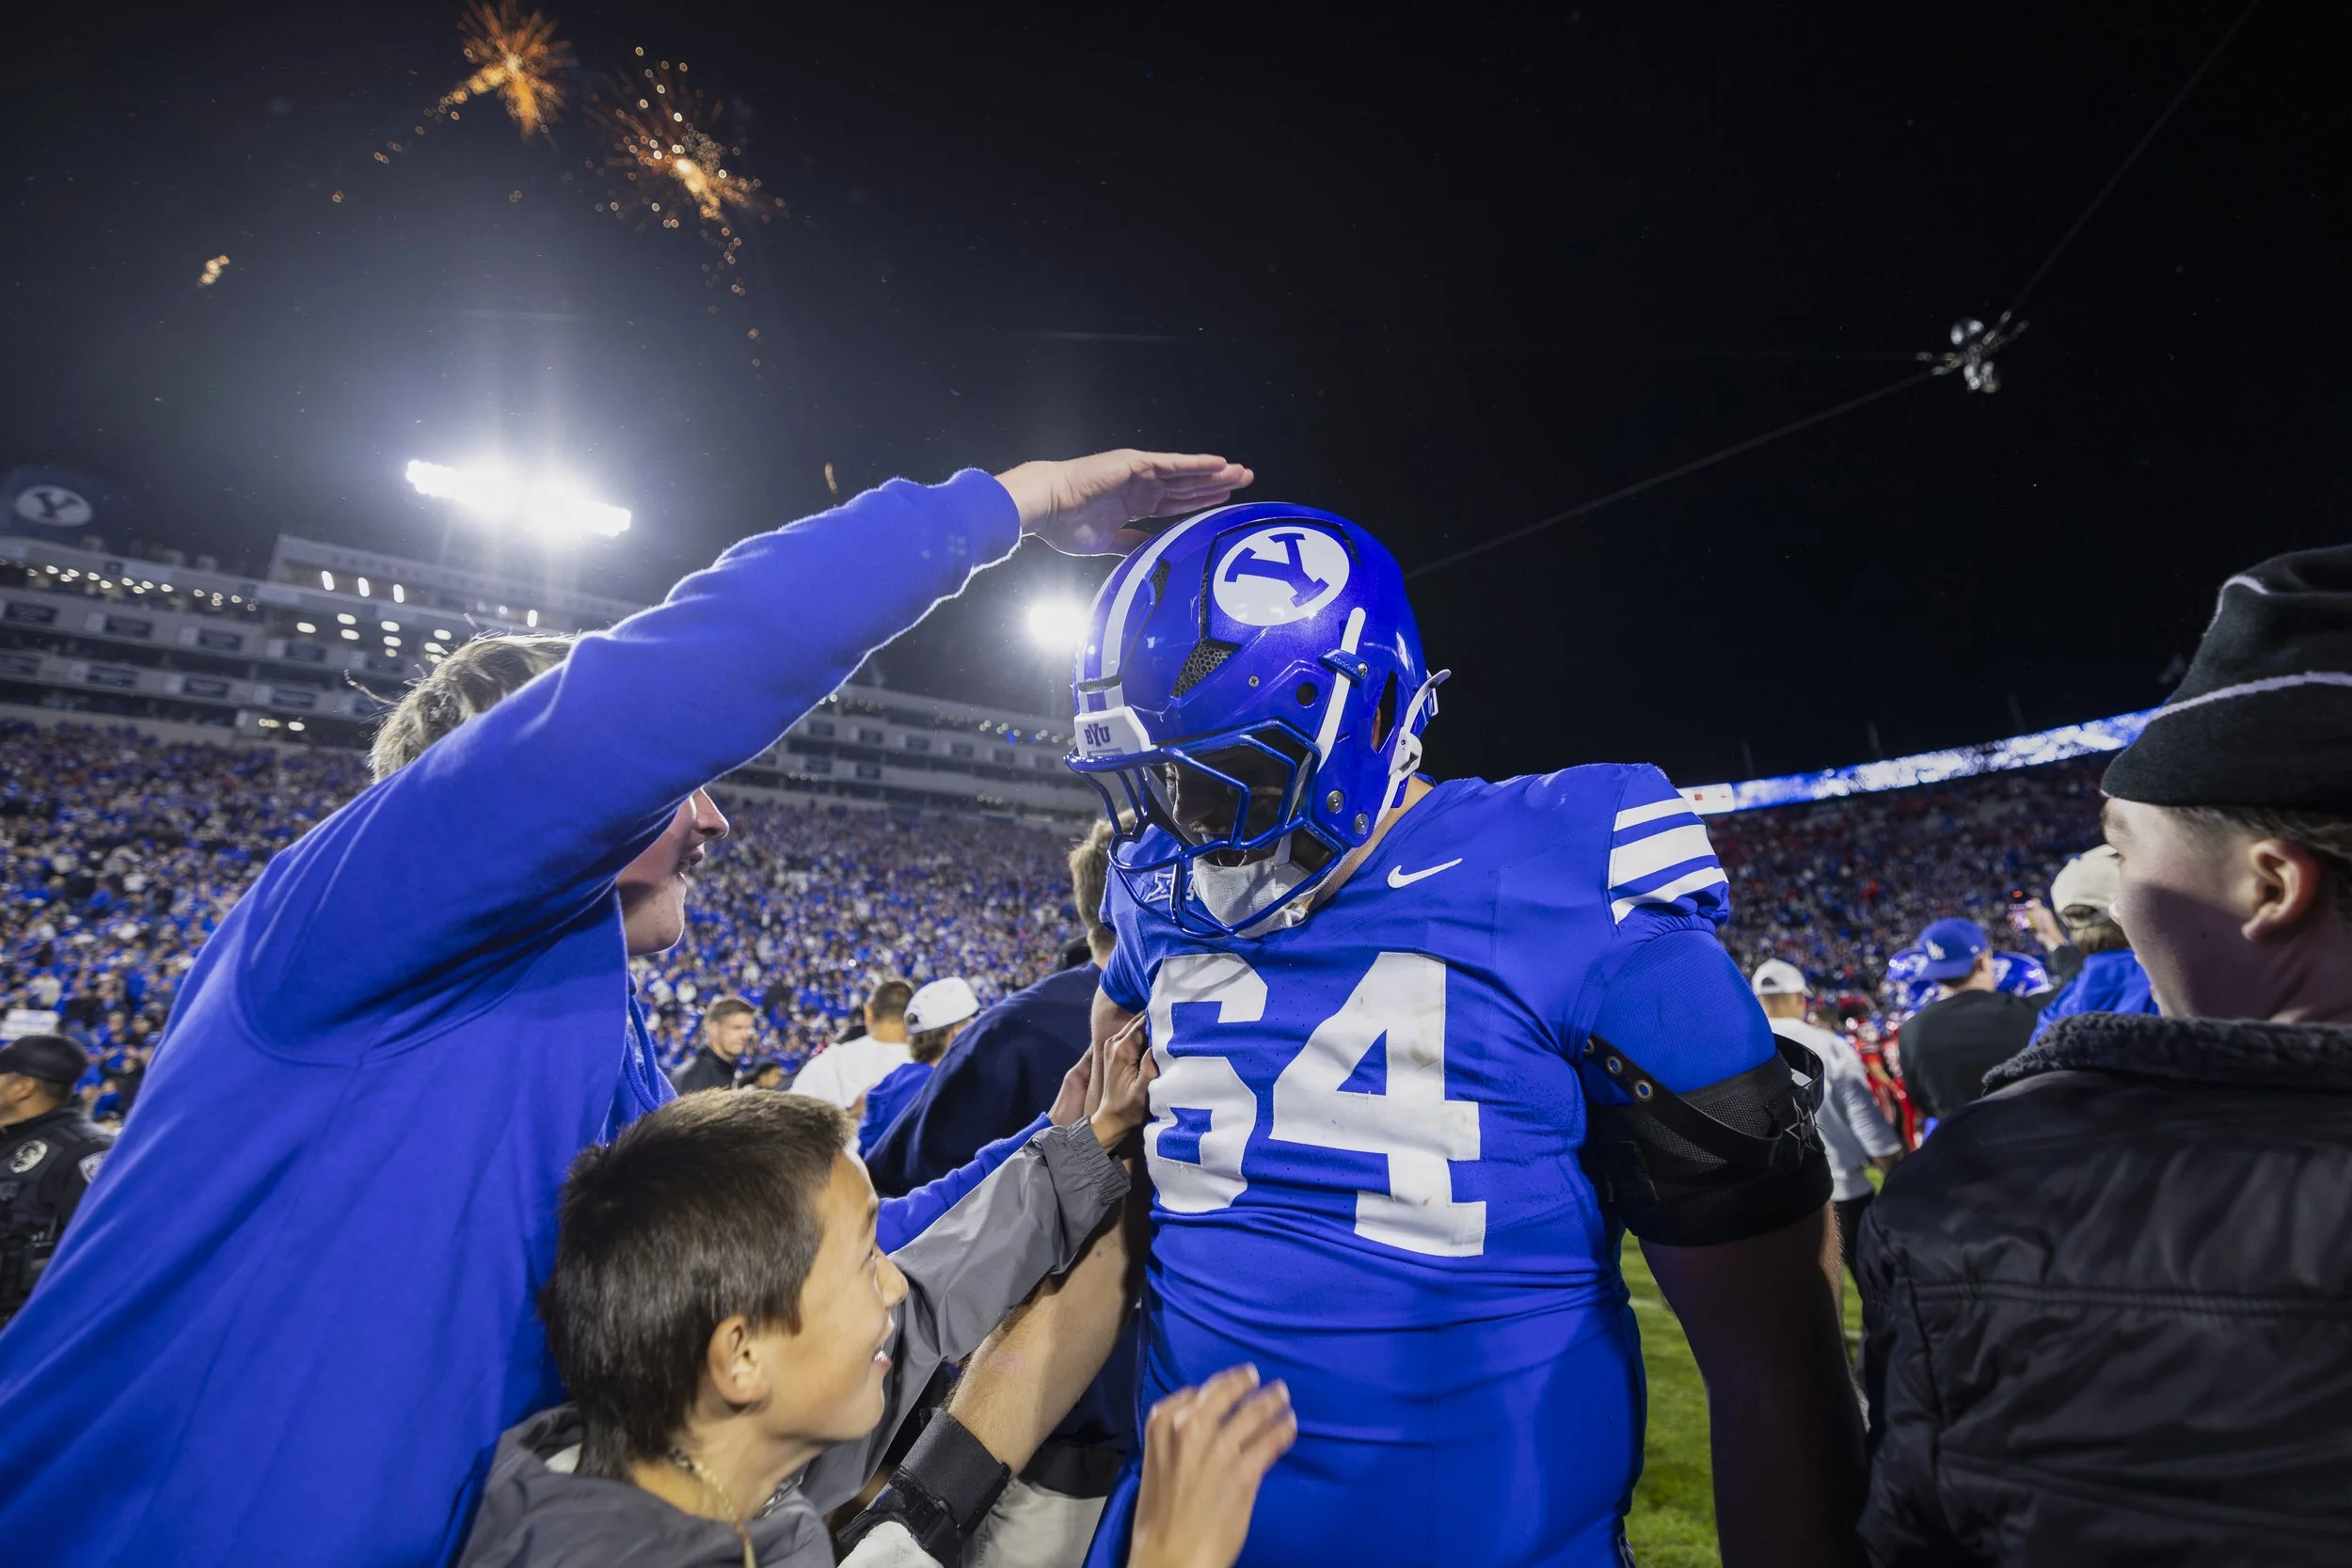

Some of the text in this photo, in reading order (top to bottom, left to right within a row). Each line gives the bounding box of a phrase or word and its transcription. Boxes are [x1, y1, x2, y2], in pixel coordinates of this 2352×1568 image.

[32, 492, 81, 519] Y
[1224, 532, 1329, 608] Y
[1084, 723, 1110, 746] BYU
[1143, 952, 1486, 1257] 64
